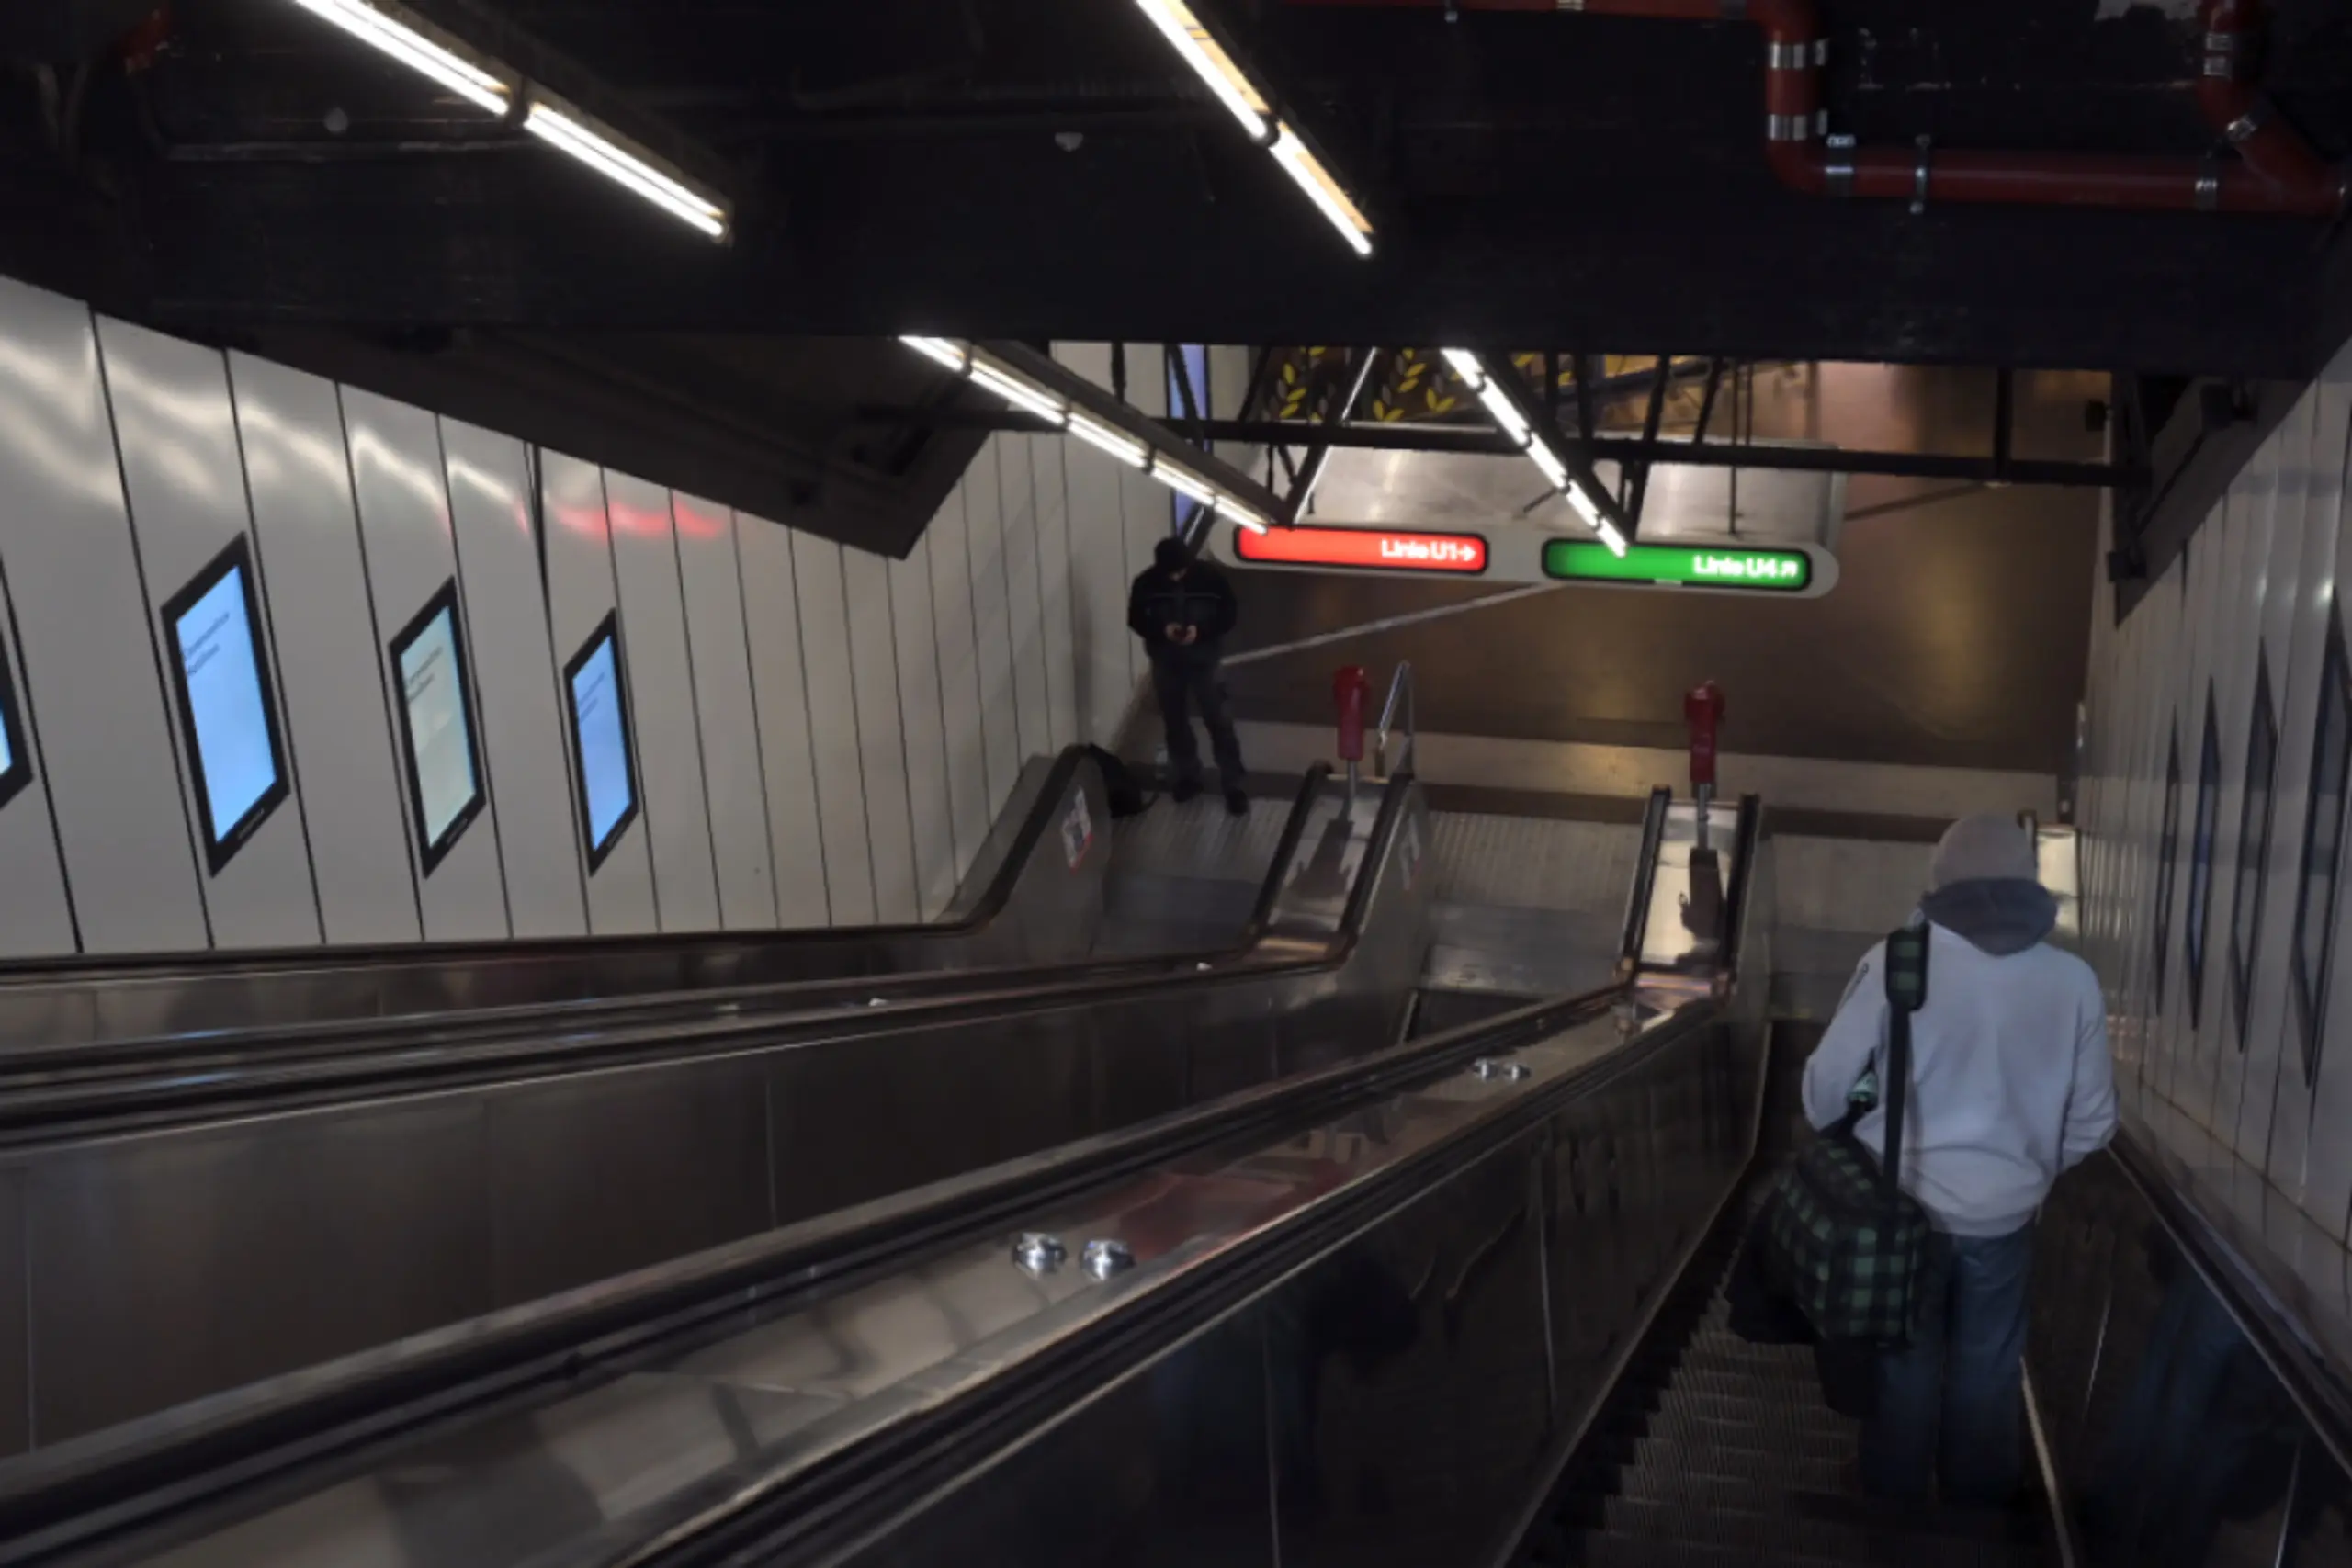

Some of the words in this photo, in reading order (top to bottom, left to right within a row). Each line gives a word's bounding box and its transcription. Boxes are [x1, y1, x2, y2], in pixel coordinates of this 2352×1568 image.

[1381, 540, 1429, 559] Linie
[1430, 541, 1457, 561] U1
[1693, 555, 1743, 575] Linie
[1746, 558, 1776, 578] U4
